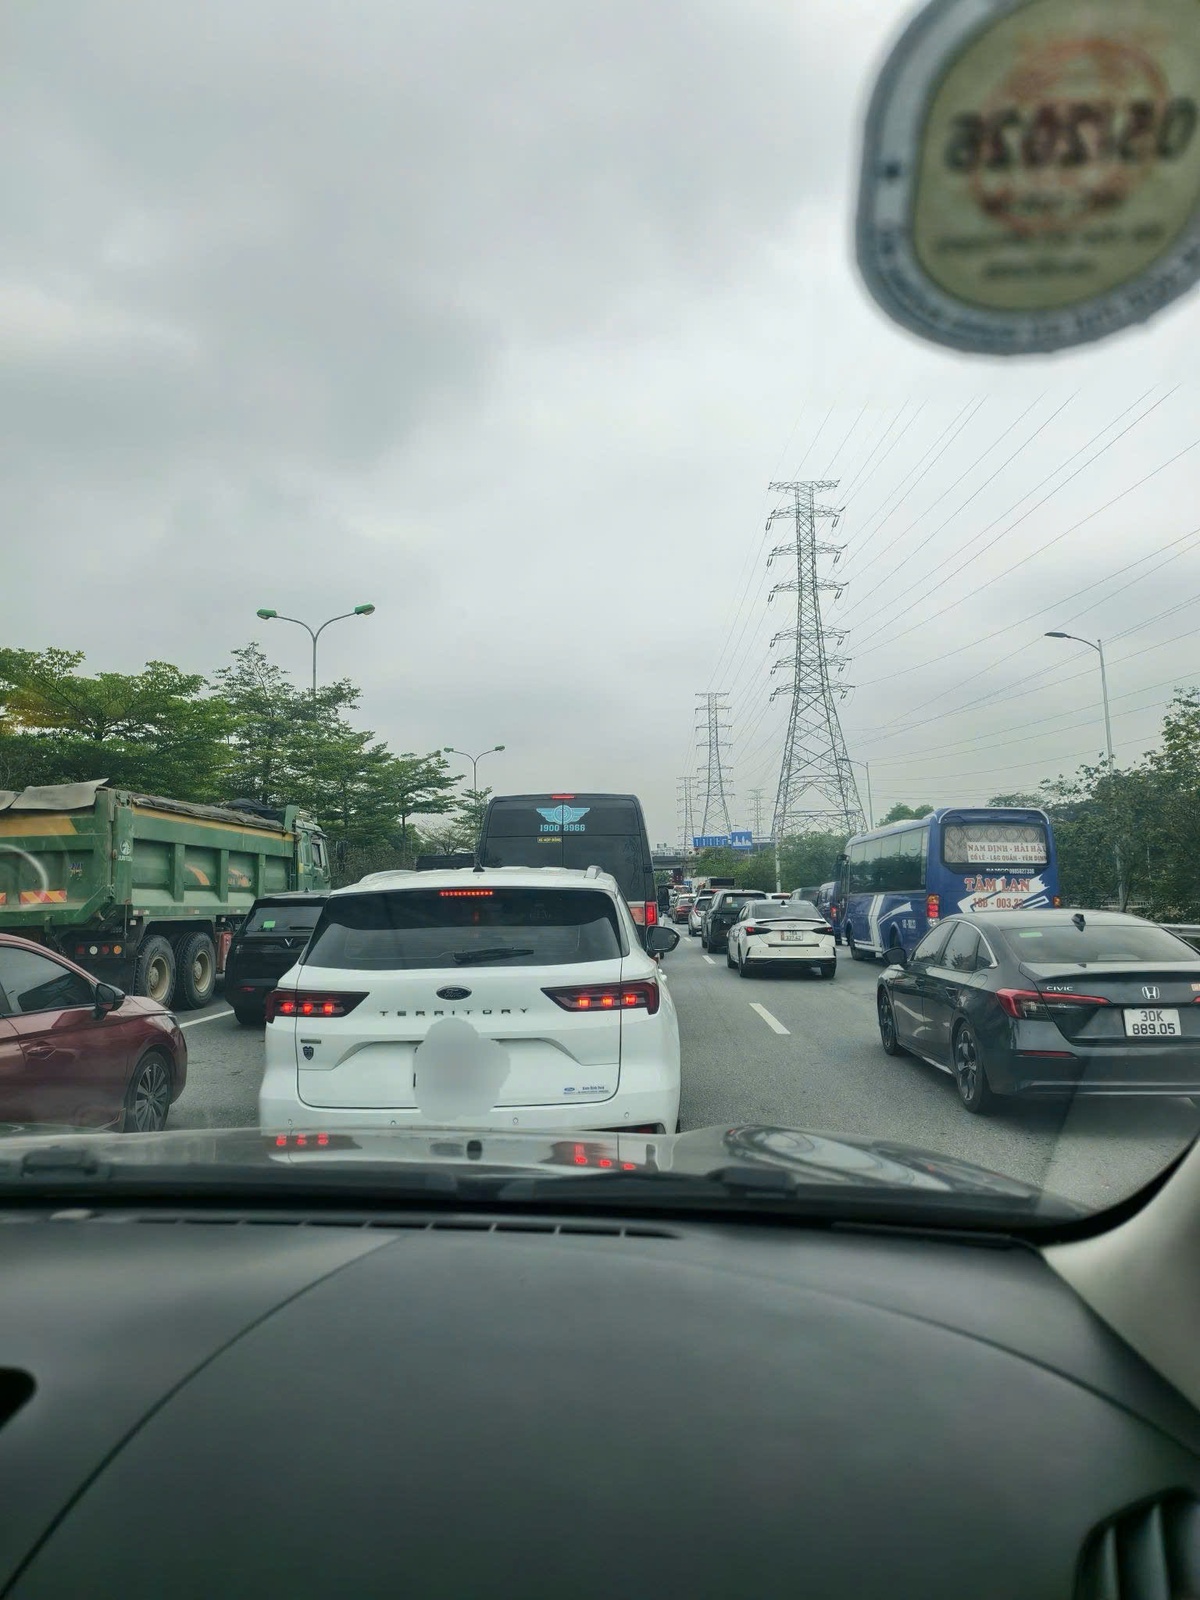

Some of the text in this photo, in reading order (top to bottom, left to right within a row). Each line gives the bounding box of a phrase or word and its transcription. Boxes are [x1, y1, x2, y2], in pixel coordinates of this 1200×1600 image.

[540, 824, 560, 832] 1900
[987, 844, 1008, 853] ĐỊNH
[964, 874, 1031, 892] TÂM LAN
[379, 1007, 529, 1017] TERRITORY
[1140, 1010, 1164, 1022] 30K
[1132, 1023, 1176, 1035] 889.05
